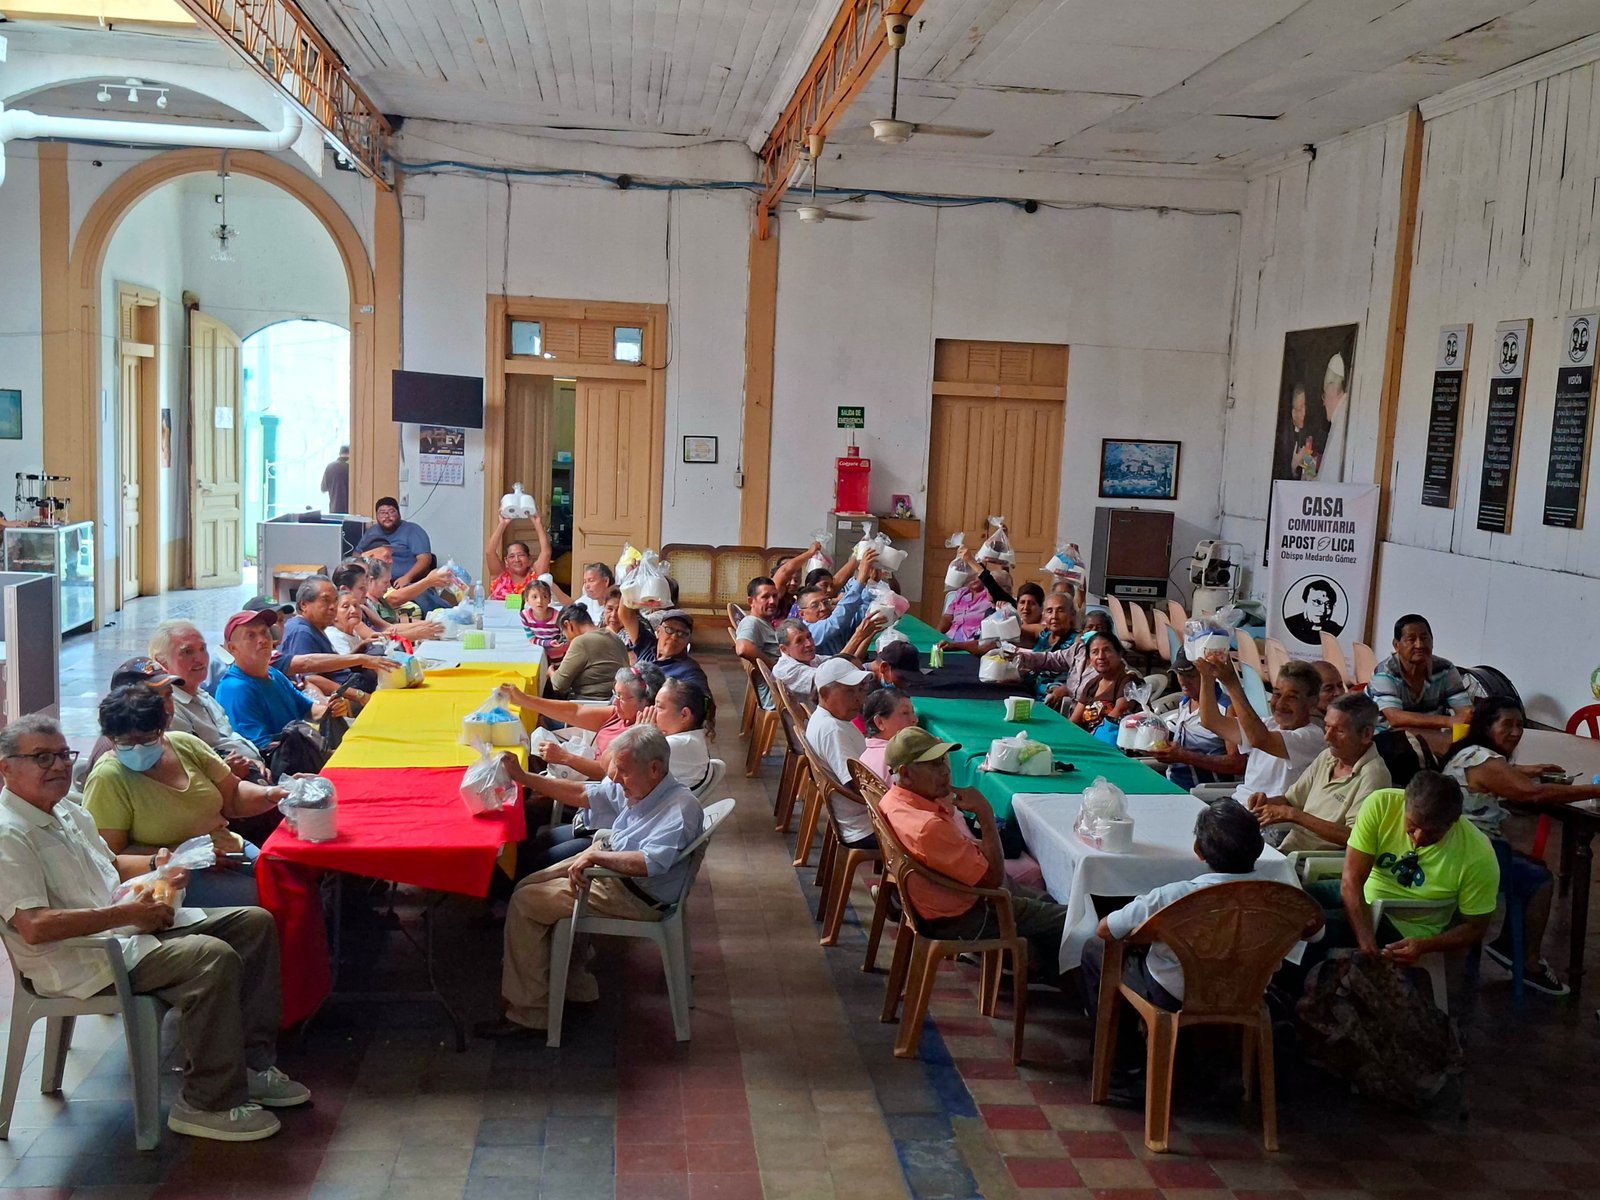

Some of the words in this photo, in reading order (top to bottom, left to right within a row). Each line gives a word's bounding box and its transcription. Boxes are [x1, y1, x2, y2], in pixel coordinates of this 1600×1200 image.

[1302, 496, 1343, 518] CASA
[1287, 518, 1356, 534] COMUNITARIA
[1280, 550, 1304, 562] Obispo
[1304, 552, 1334, 563] Medardo
[1334, 554, 1357, 564] Gómez
